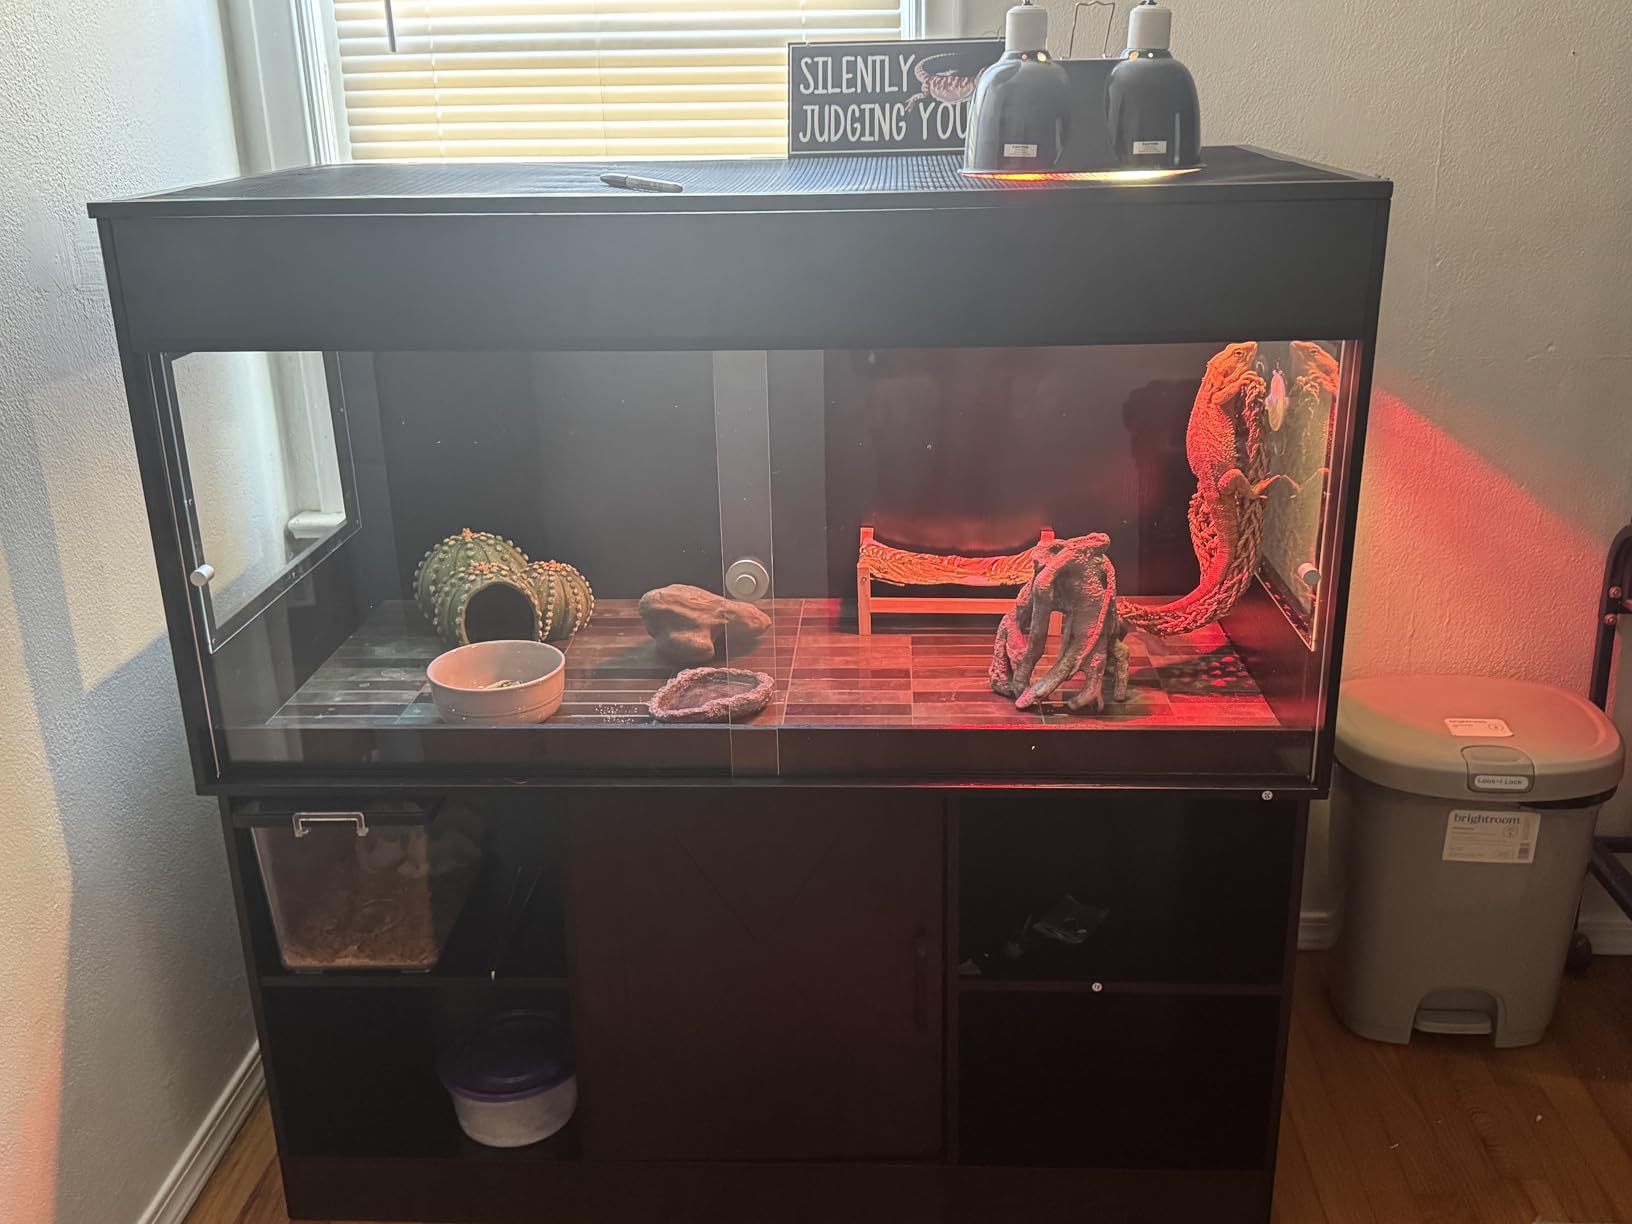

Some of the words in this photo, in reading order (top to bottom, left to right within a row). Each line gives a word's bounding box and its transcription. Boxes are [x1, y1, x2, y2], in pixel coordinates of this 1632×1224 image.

[800, 54, 915, 94] SILENTLY
[799, 103, 907, 142] JUDGING
[1454, 813, 1520, 824] brightroom
